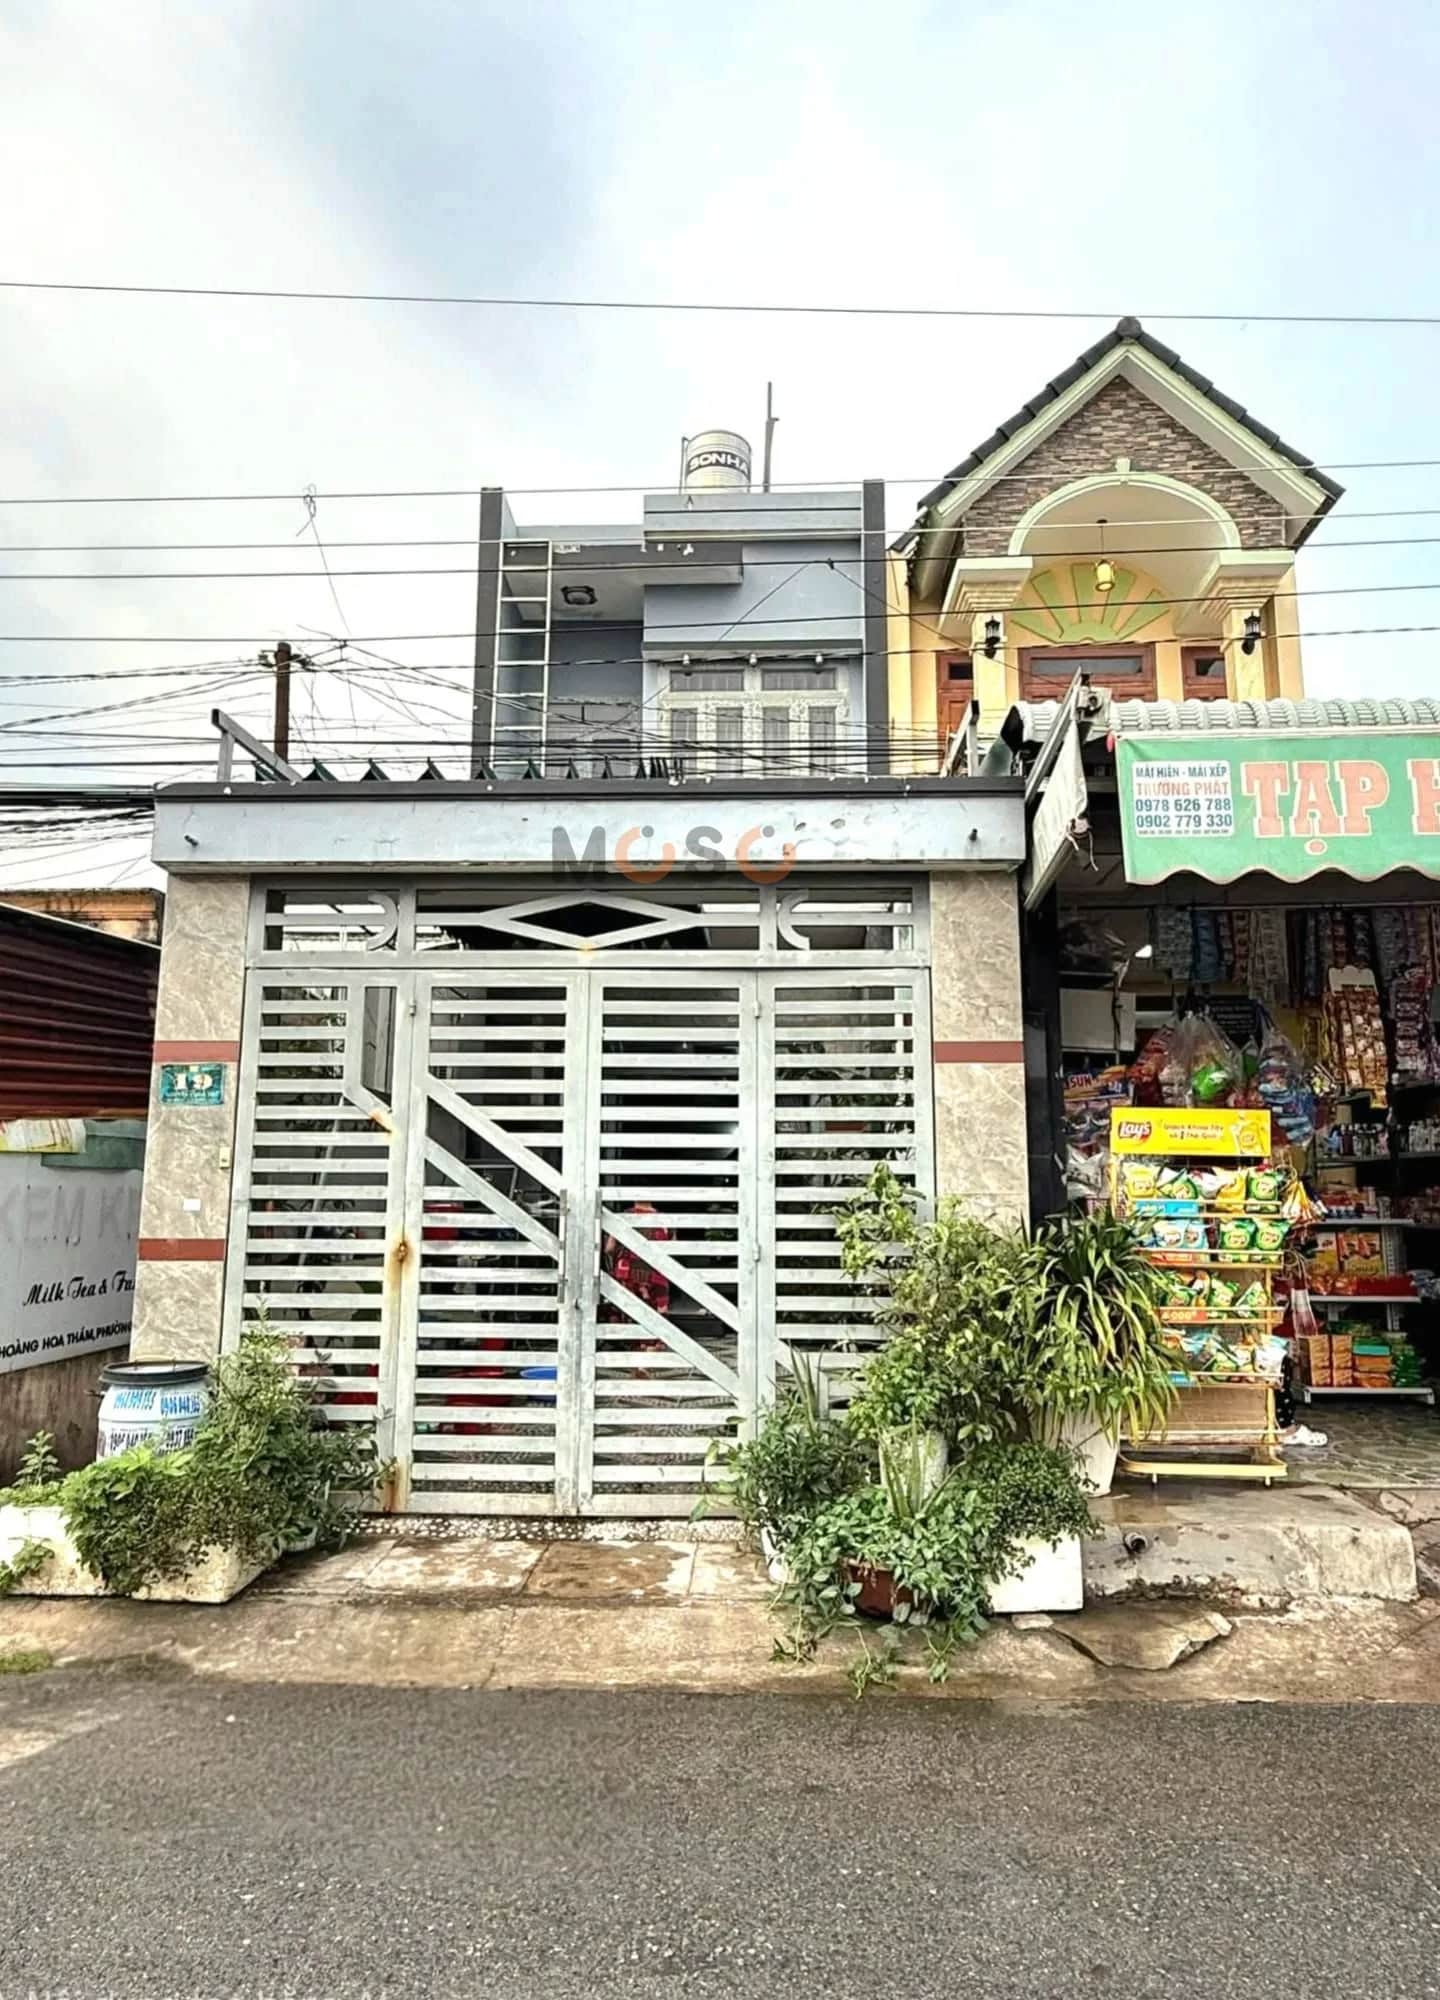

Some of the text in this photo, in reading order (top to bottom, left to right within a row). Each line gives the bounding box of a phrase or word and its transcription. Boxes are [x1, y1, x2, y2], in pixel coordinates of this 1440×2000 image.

[1209, 763, 1227, 777] XẾP
[1194, 780, 1228, 795] PHÁT
[1135, 798, 1231, 812] 0978 626 788
[1240, 760, 1390, 856] TẠP
[1136, 814, 1233, 828] 0902 779 330
[22, 1281, 65, 1307] Milk
[66, 1276, 97, 1300] Tea
[97, 1278, 108, 1295] &
[42, 1333, 65, 1351] HOA
